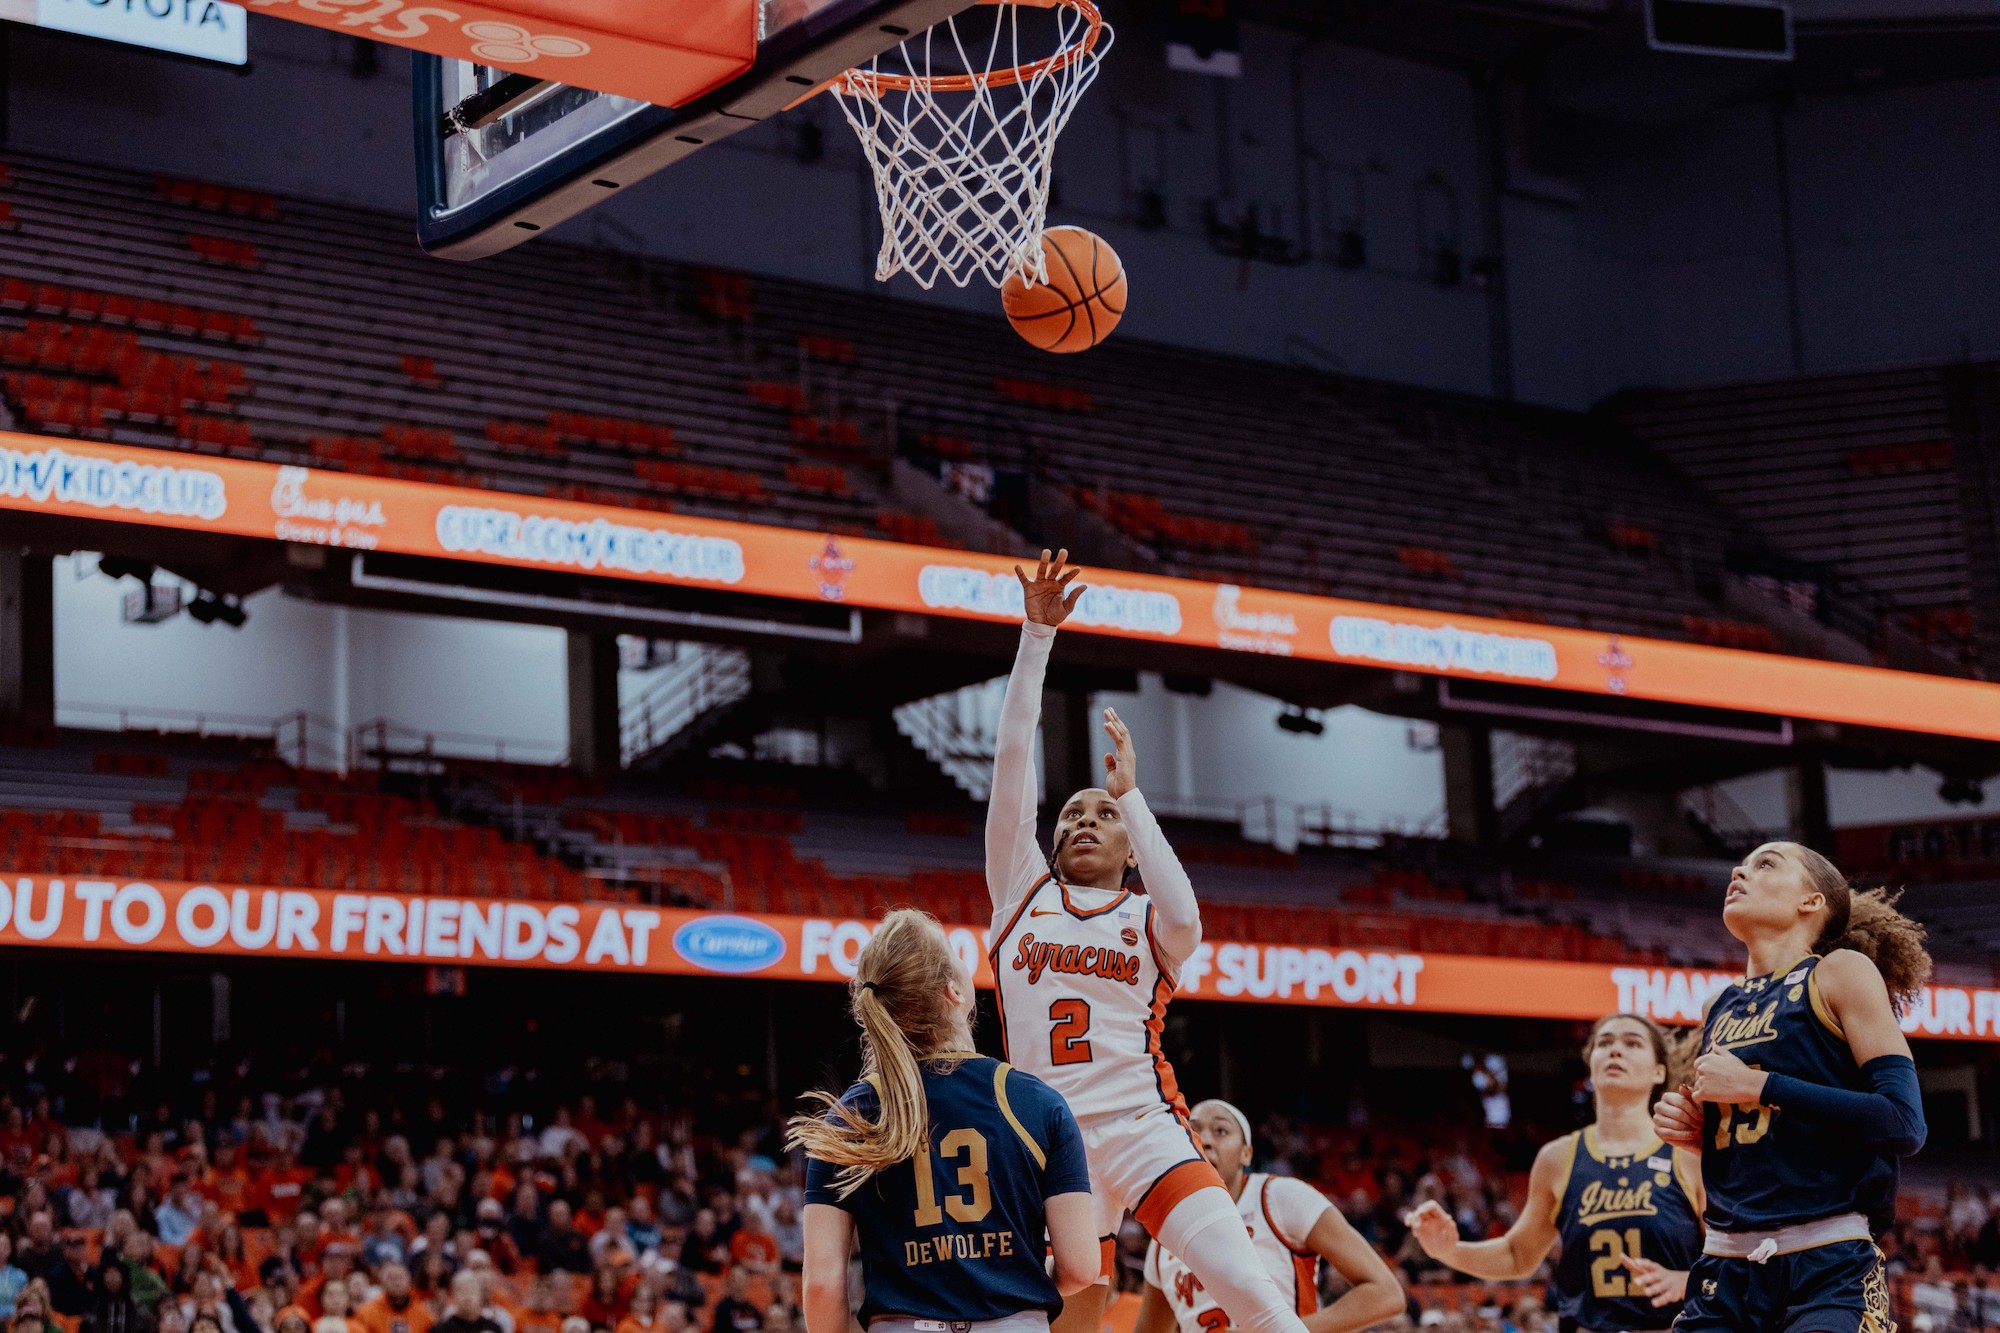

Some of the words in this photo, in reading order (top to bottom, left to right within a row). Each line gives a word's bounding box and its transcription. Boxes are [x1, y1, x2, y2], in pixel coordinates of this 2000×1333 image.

[0, 878, 65, 939] U
[75, 881, 166, 945] TO
[175, 886, 320, 951] OUR
[330, 894, 581, 964] FRIENDS
[583, 908, 661, 967] AT
[801, 920, 883, 976] FO
[1013, 932, 1140, 985] Syracuse
[1180, 943, 1214, 994] F
[1216, 943, 1424, 1005] SUPPORT
[1049, 998, 1093, 1066] 2
[1706, 1001, 1778, 1051] Irish
[912, 1126, 993, 1228] 13
[1578, 1180, 1658, 1225] Irish
[1589, 1228, 1650, 1298] 21
